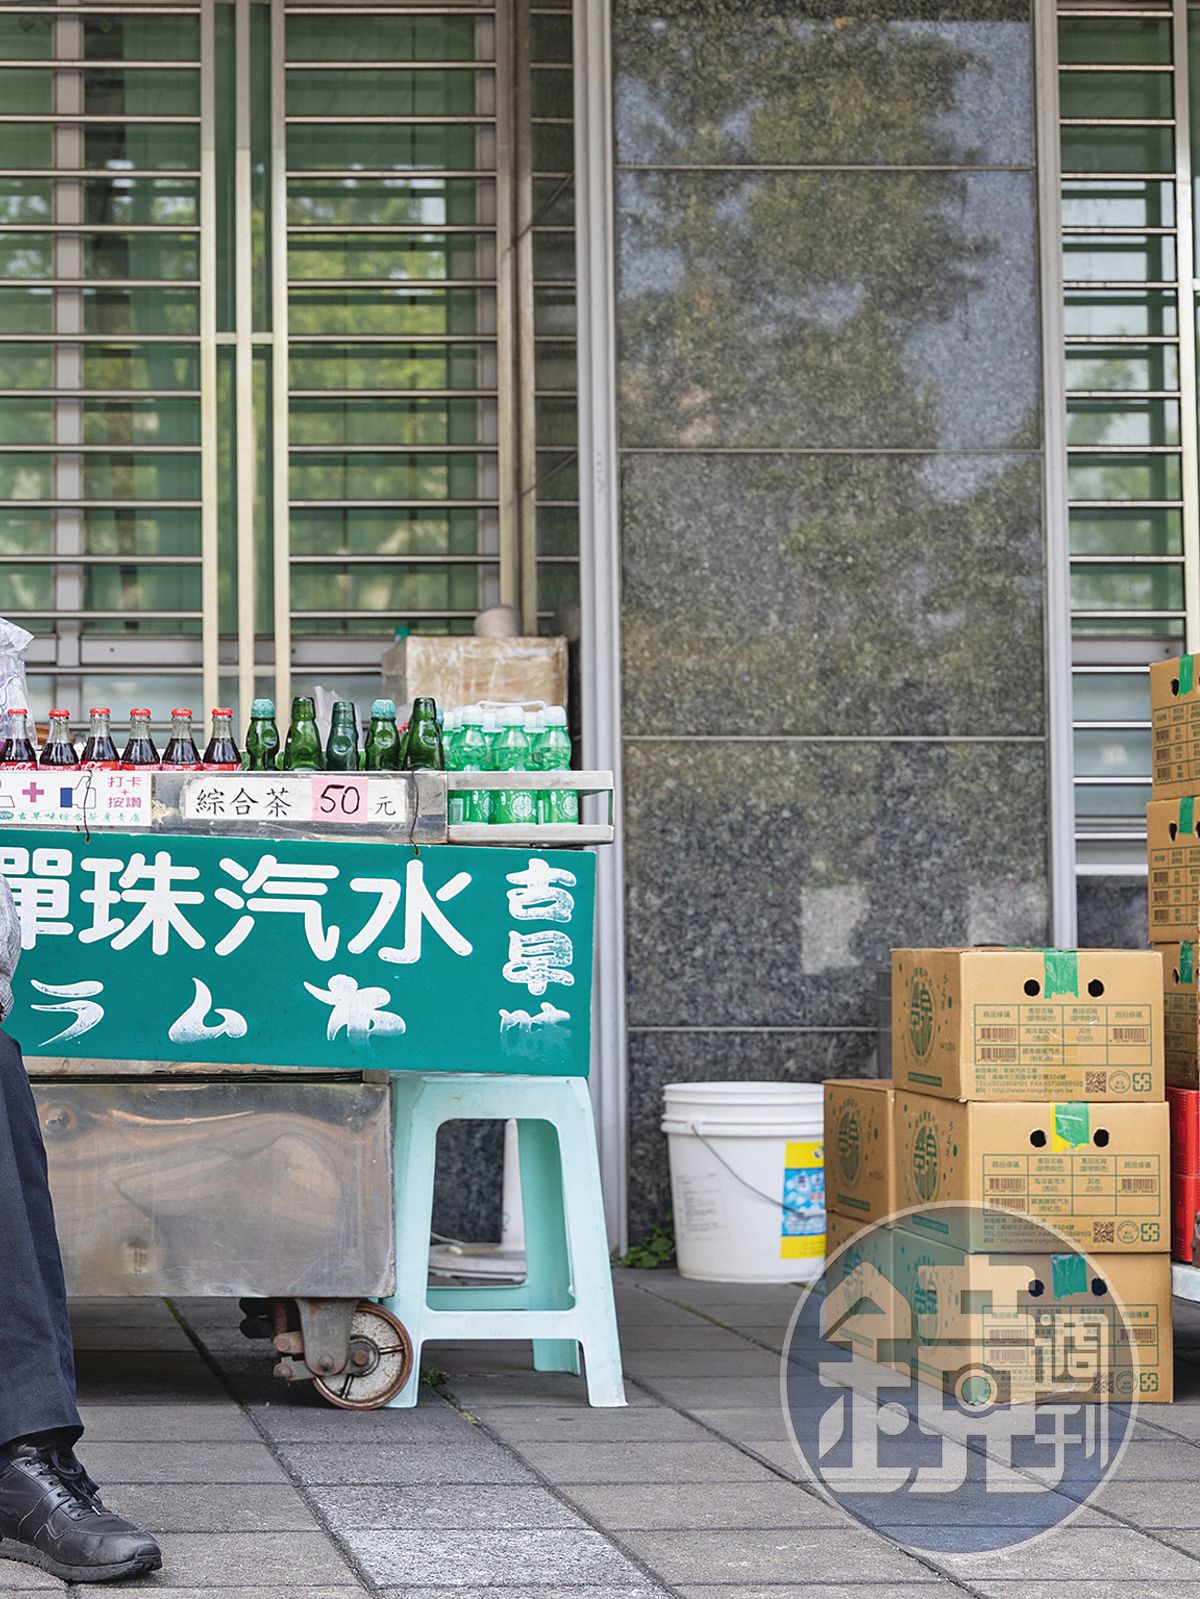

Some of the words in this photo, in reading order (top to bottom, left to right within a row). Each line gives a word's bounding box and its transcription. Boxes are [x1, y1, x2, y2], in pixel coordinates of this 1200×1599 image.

[107, 776, 142, 788] 打卡
[195, 786, 292, 817] 綜合茶
[320, 784, 360, 814] 50
[375, 796, 396, 816] 元
